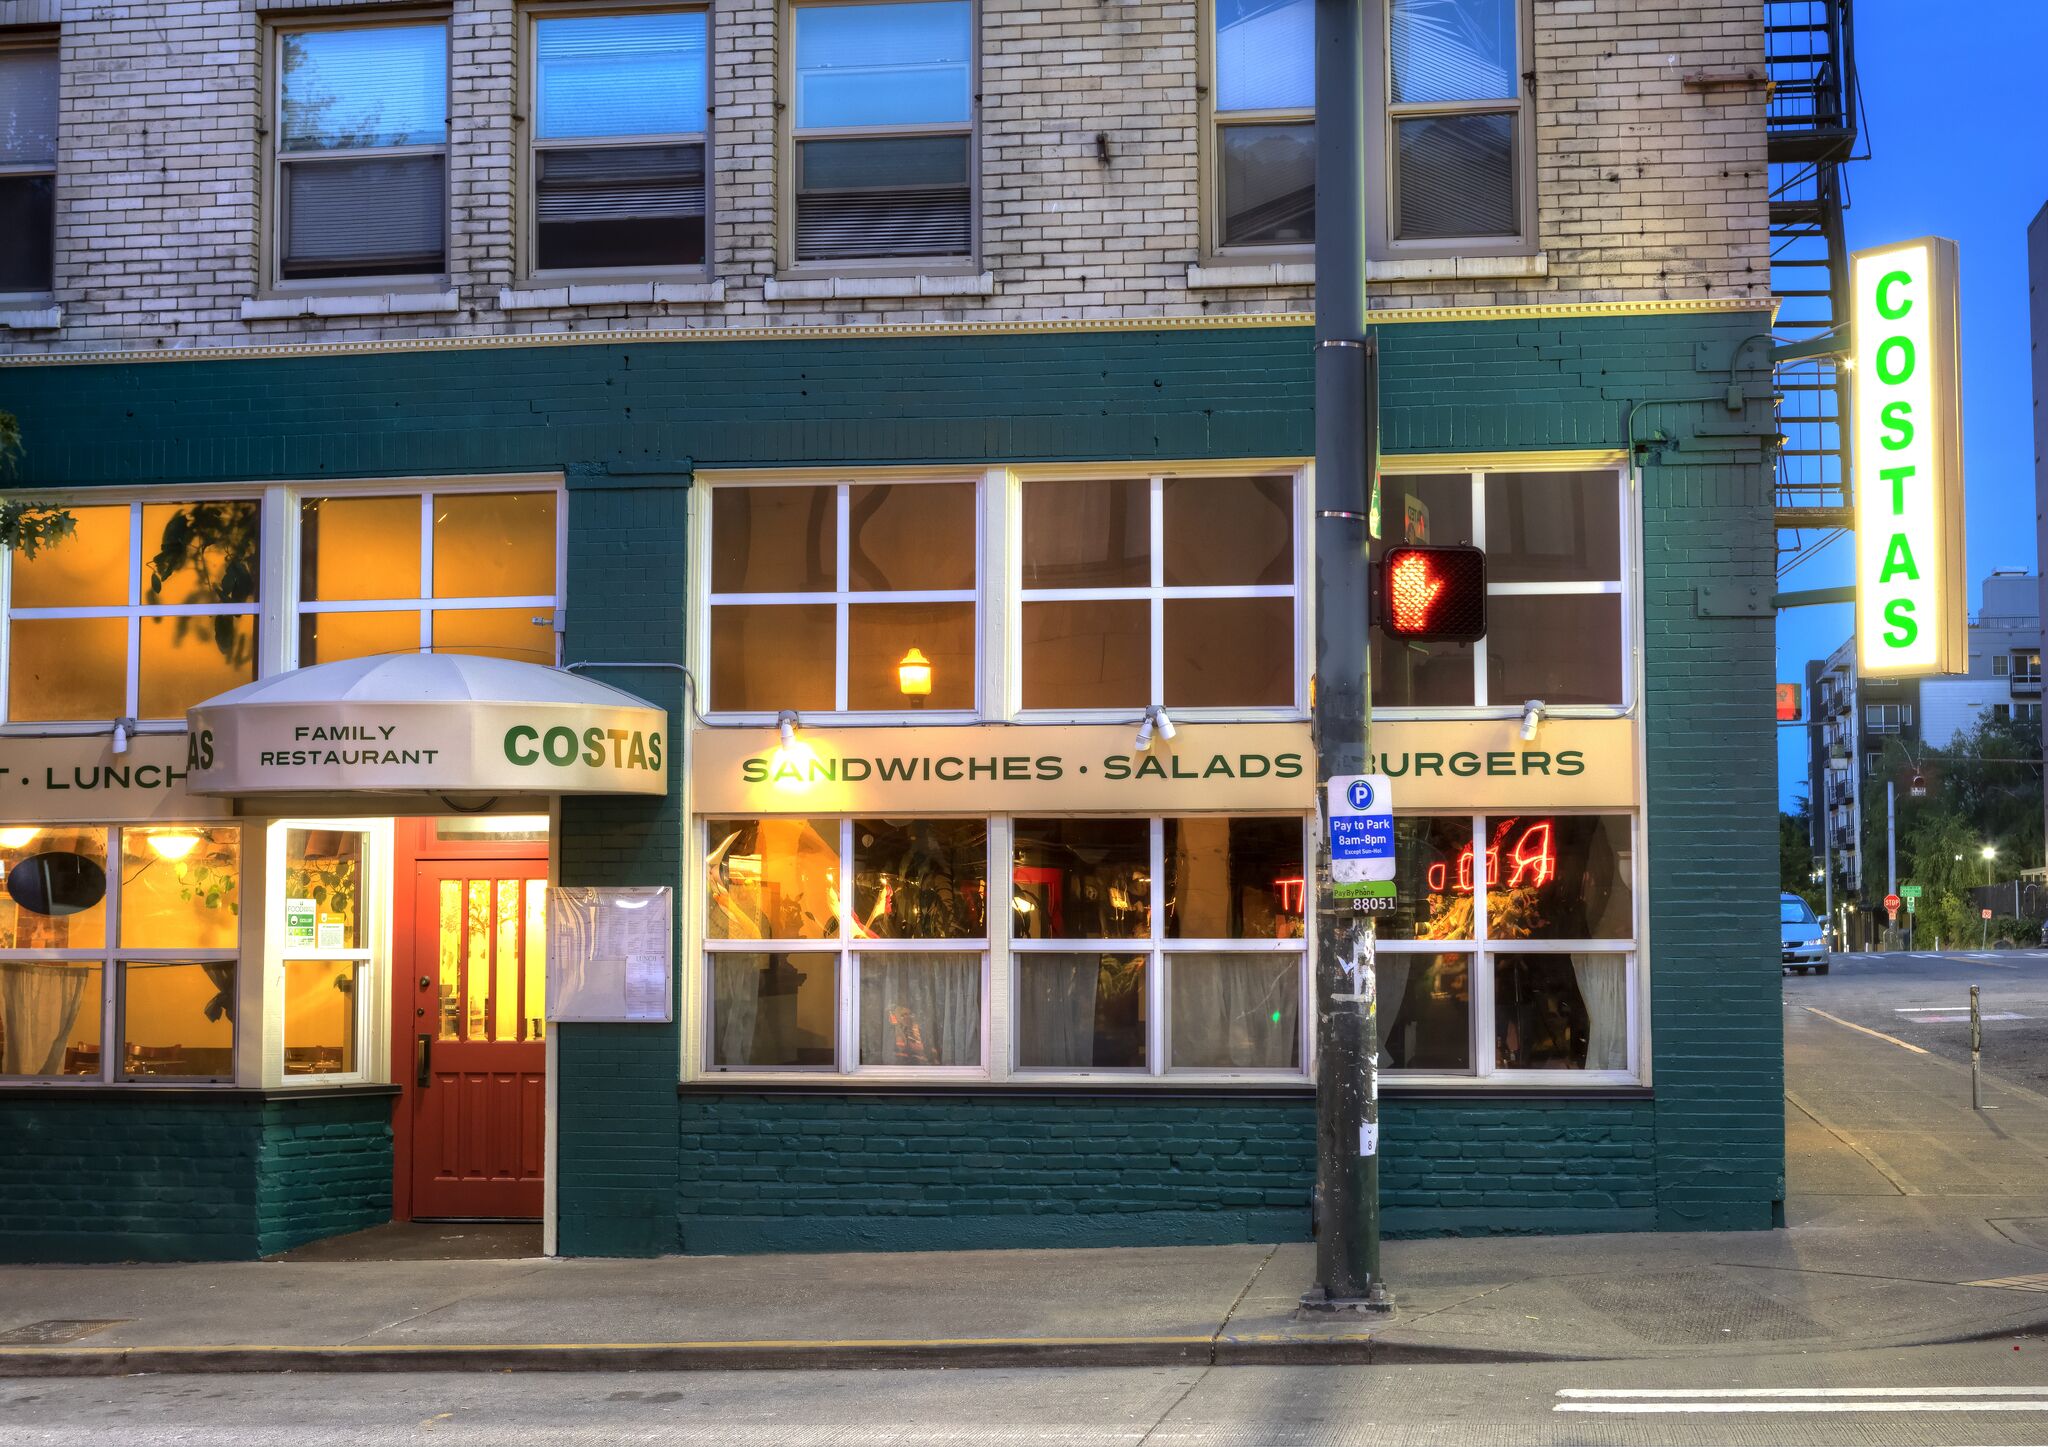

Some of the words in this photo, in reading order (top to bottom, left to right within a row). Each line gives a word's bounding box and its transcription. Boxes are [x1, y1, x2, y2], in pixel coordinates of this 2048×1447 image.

[1876, 270, 1920, 648] COSTAS
[295, 725, 396, 741] FAMILY
[503, 725, 662, 772] COSTAS
[260, 750, 439, 766] RESTAURANT
[742, 755, 1064, 783] SANDWICHES
[1103, 753, 1303, 780] SALADS
[1370, 750, 1585, 777] URGERS
[1356, 787, 1368, 804] P
[1334, 820, 1351, 832] Pay
[1354, 820, 1365, 830] to
[1366, 819, 1390, 830] Park
[1339, 834, 1386, 846] 8am-8pm
[1353, 898, 1395, 910] 88051
